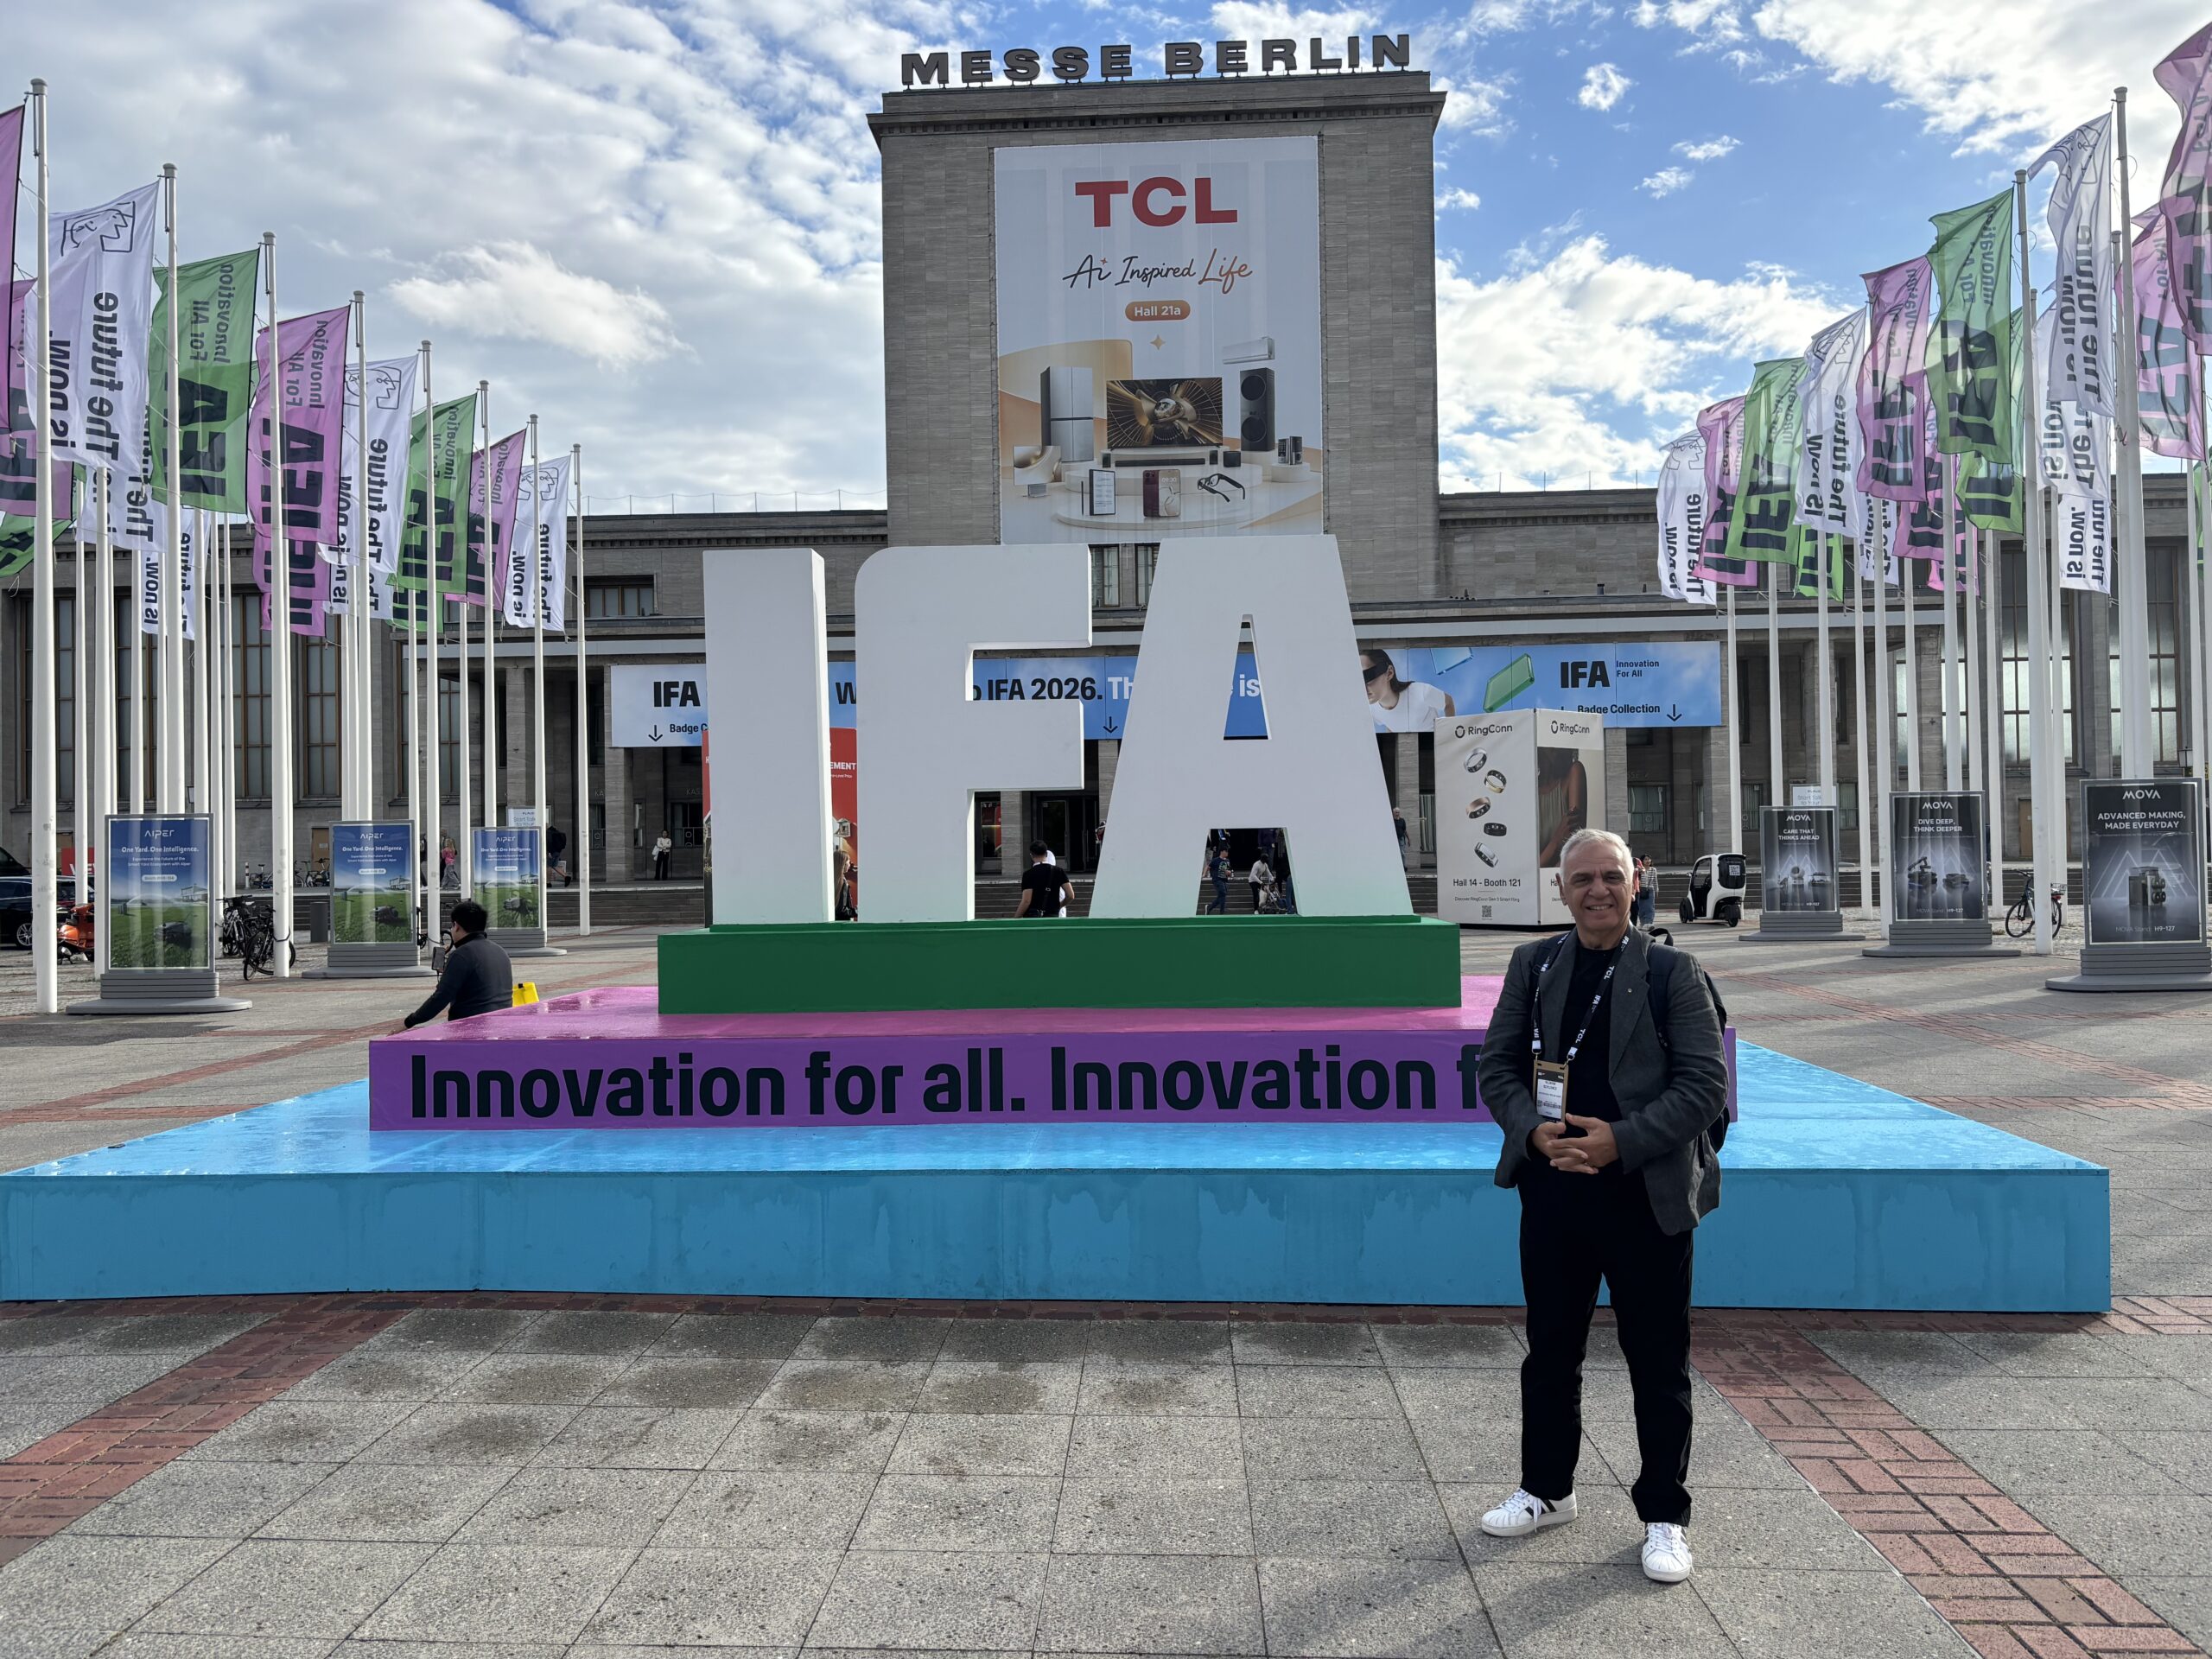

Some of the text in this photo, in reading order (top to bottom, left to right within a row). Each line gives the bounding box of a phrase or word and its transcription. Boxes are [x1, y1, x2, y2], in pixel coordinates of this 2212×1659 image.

[901, 34, 1410, 86] MESSE BERLIN
[1075, 177, 1237, 227] TCL
[1115, 256, 1196, 288] Inspired
[1198, 248, 1252, 294] Life
[1135, 305, 1180, 316] Hall 21a
[1560, 660, 1610, 688] IFA
[988, 679, 1025, 701] IFA
[1031, 677, 1103, 700] 2026.
[1108, 677, 1133, 700] Th
[1239, 674, 1260, 696] is
[653, 681, 701, 707] IFA
[1578, 704, 1660, 714] Badge Collection
[670, 723, 698, 734] Badge
[702, 534, 1414, 926] IFA
[1468, 724, 1513, 735] RingConn
[1560, 723, 1590, 734] RingConn
[2123, 790, 2161, 799] MOVA
[2149, 811, 2186, 820] MAKING,
[2133, 821, 2179, 830] EVERYDAY
[1604, 966, 1615, 980] TCL
[1575, 1028, 1586, 1044] TCL
[412, 1052, 785, 1119] Innovation
[804, 1051, 904, 1115] for
[923, 1047, 1026, 1113] all.
[1052, 1044, 1434, 1112] Innovation
